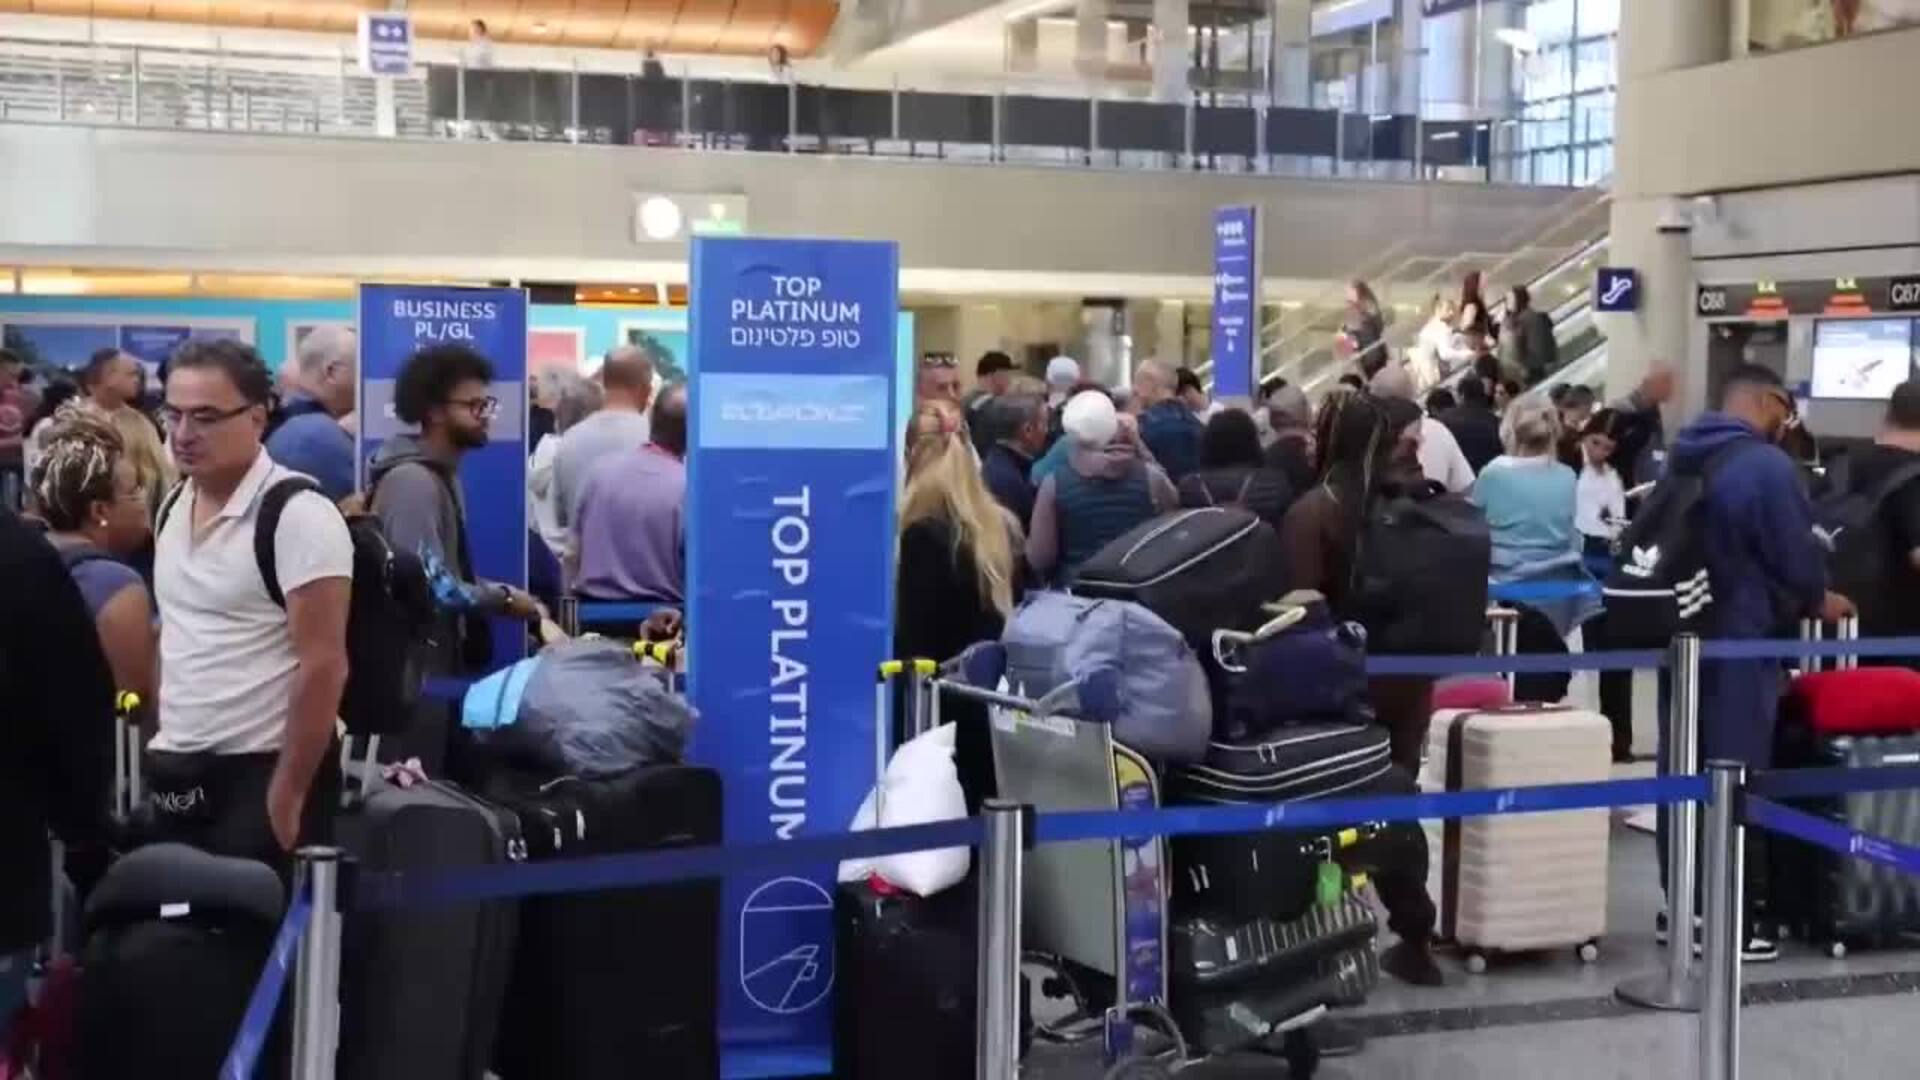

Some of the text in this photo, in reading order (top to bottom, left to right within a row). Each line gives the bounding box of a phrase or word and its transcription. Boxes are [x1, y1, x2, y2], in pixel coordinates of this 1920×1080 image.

[771, 275, 821, 297] TOP
[393, 300, 496, 319] BUSINESS
[731, 299, 860, 323] PLATINUM
[415, 321, 475, 340] PL/GL
[731, 326, 815, 348] פלטינום
[771, 485, 810, 586] TOP
